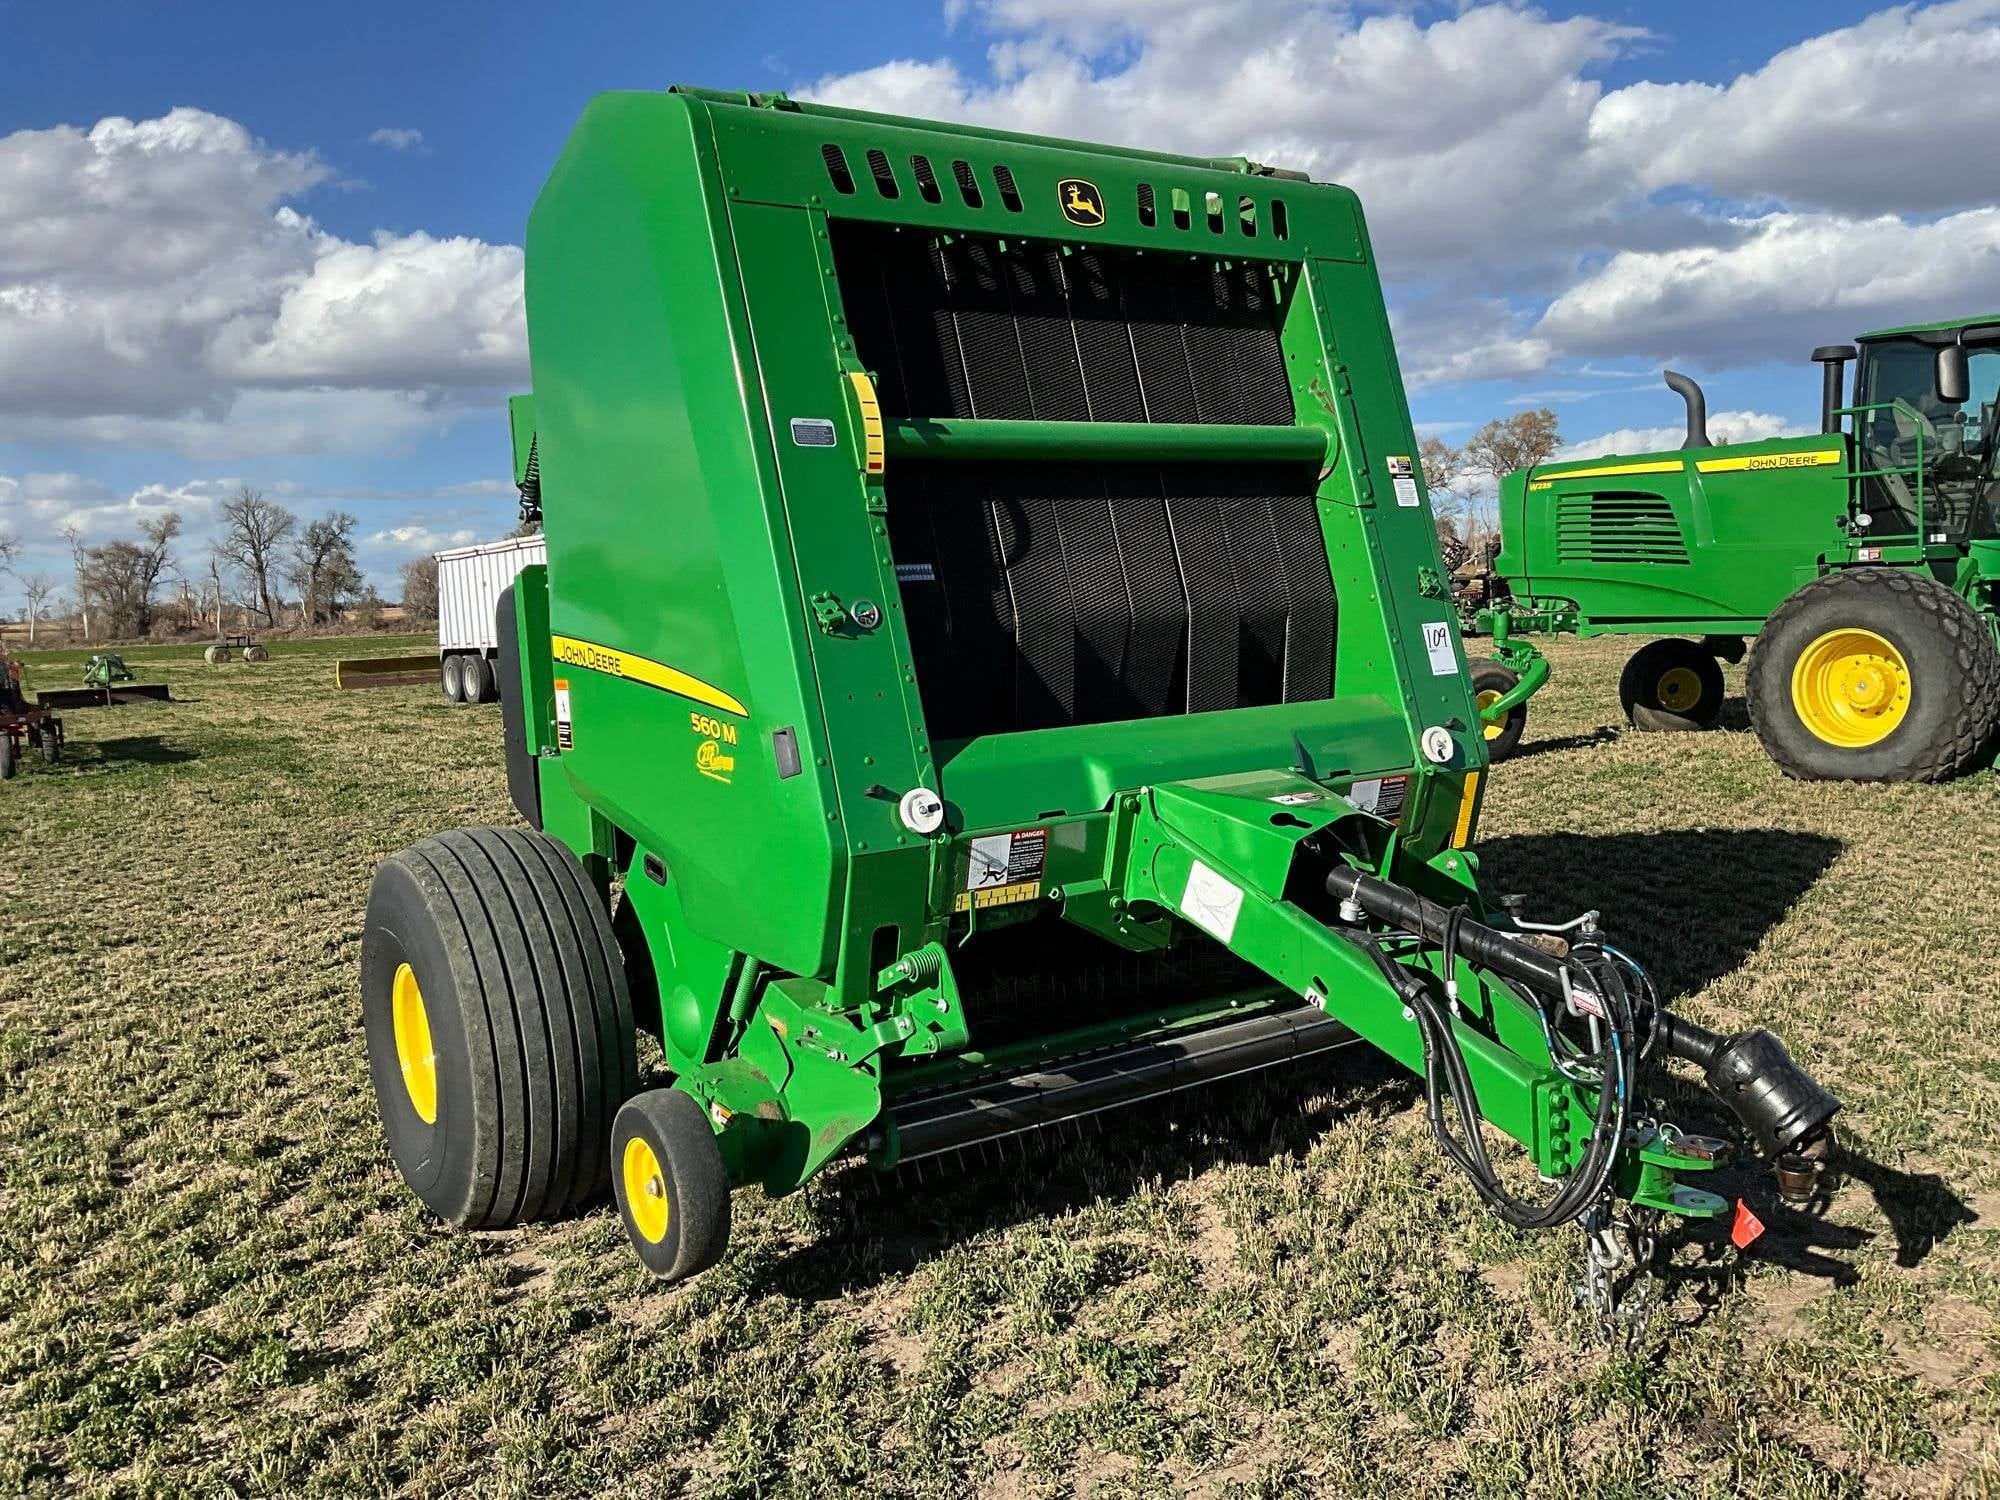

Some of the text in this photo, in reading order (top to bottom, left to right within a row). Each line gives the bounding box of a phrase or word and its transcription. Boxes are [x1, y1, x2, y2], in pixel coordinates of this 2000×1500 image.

[1746, 456, 1818, 469] JOHN DEERE
[1426, 627, 1448, 649] 109
[561, 645, 622, 674] JOHN DEERE
[690, 711, 738, 747] 560 M
[1021, 829, 1045, 839] DANGER
